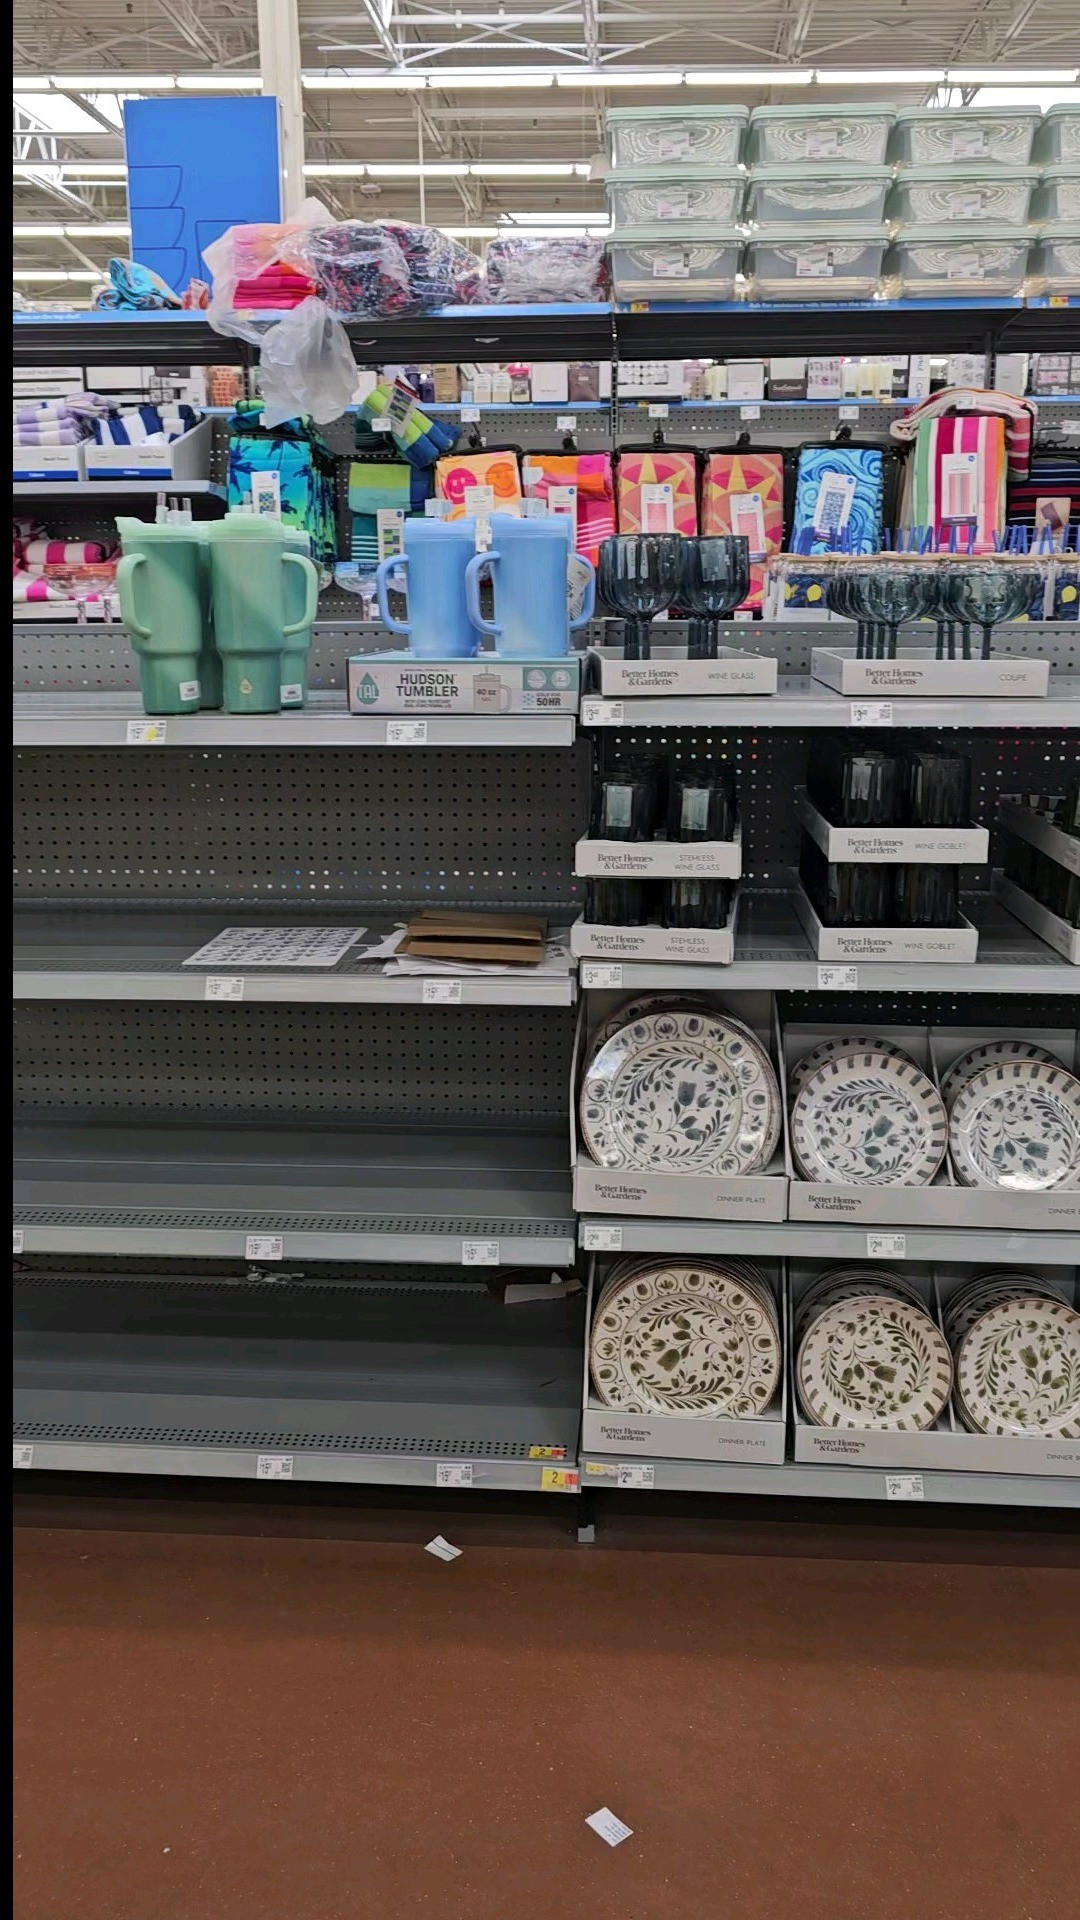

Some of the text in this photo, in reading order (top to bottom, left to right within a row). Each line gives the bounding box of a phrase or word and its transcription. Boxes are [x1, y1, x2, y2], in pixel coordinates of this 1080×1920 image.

[621, 669, 679, 678] Better Homes
[865, 668, 924, 677] Better Homes
[999, 673, 1028, 681] COUPE
[400, 673, 454, 685] HUDSON
[396, 685, 459, 697] TUMBLER
[476, 688, 487, 696] 40
[847, 838, 903, 847] Better Homes
[598, 853, 653, 862] Better Homes
[679, 854, 715, 862] STEMLESS
[590, 934, 645, 943] Better Homes
[670, 937, 705, 945] STEMLESS
[837, 938, 893, 946] Better Homes
[686, 946, 710, 954] GLASS
[594, 1184, 648, 1194] Better Homes
[716, 1195, 744, 1203] DINNER
[808, 1194, 862, 1205] Better Homes
[600, 1425, 652, 1436] Better Homes
[747, 1439, 766, 1447] PLATE
[813, 1437, 866, 1448] Better Homes
[538, 1447, 547, 1456] 2
[1046, 1453, 1073, 1461] DINNER
[551, 1471, 559, 1484] 2
